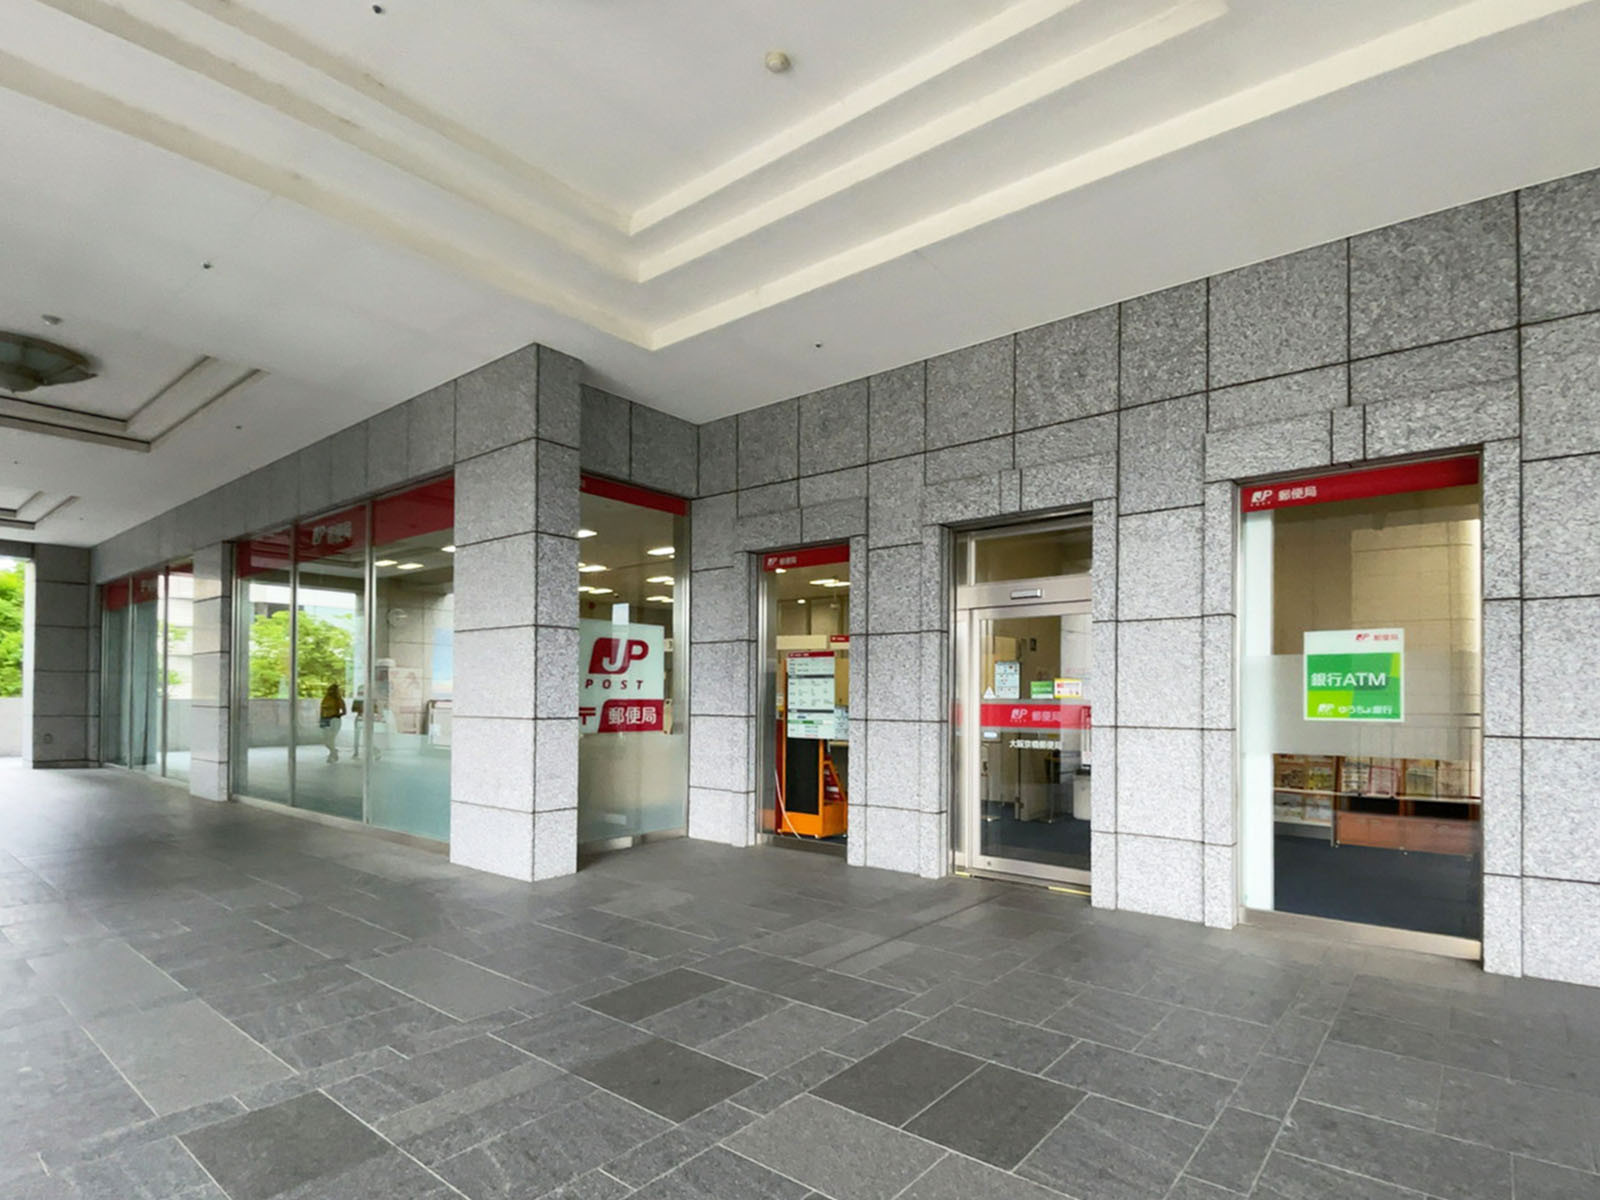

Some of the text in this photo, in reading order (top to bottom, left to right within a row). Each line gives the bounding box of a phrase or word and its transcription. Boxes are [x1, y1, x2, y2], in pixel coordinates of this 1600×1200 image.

[1277, 485, 1317, 502] 郵便局
[585, 679, 643, 690] POST
[1310, 671, 1387, 687] 銀行ATM
[608, 706, 657, 725] 郵便局
